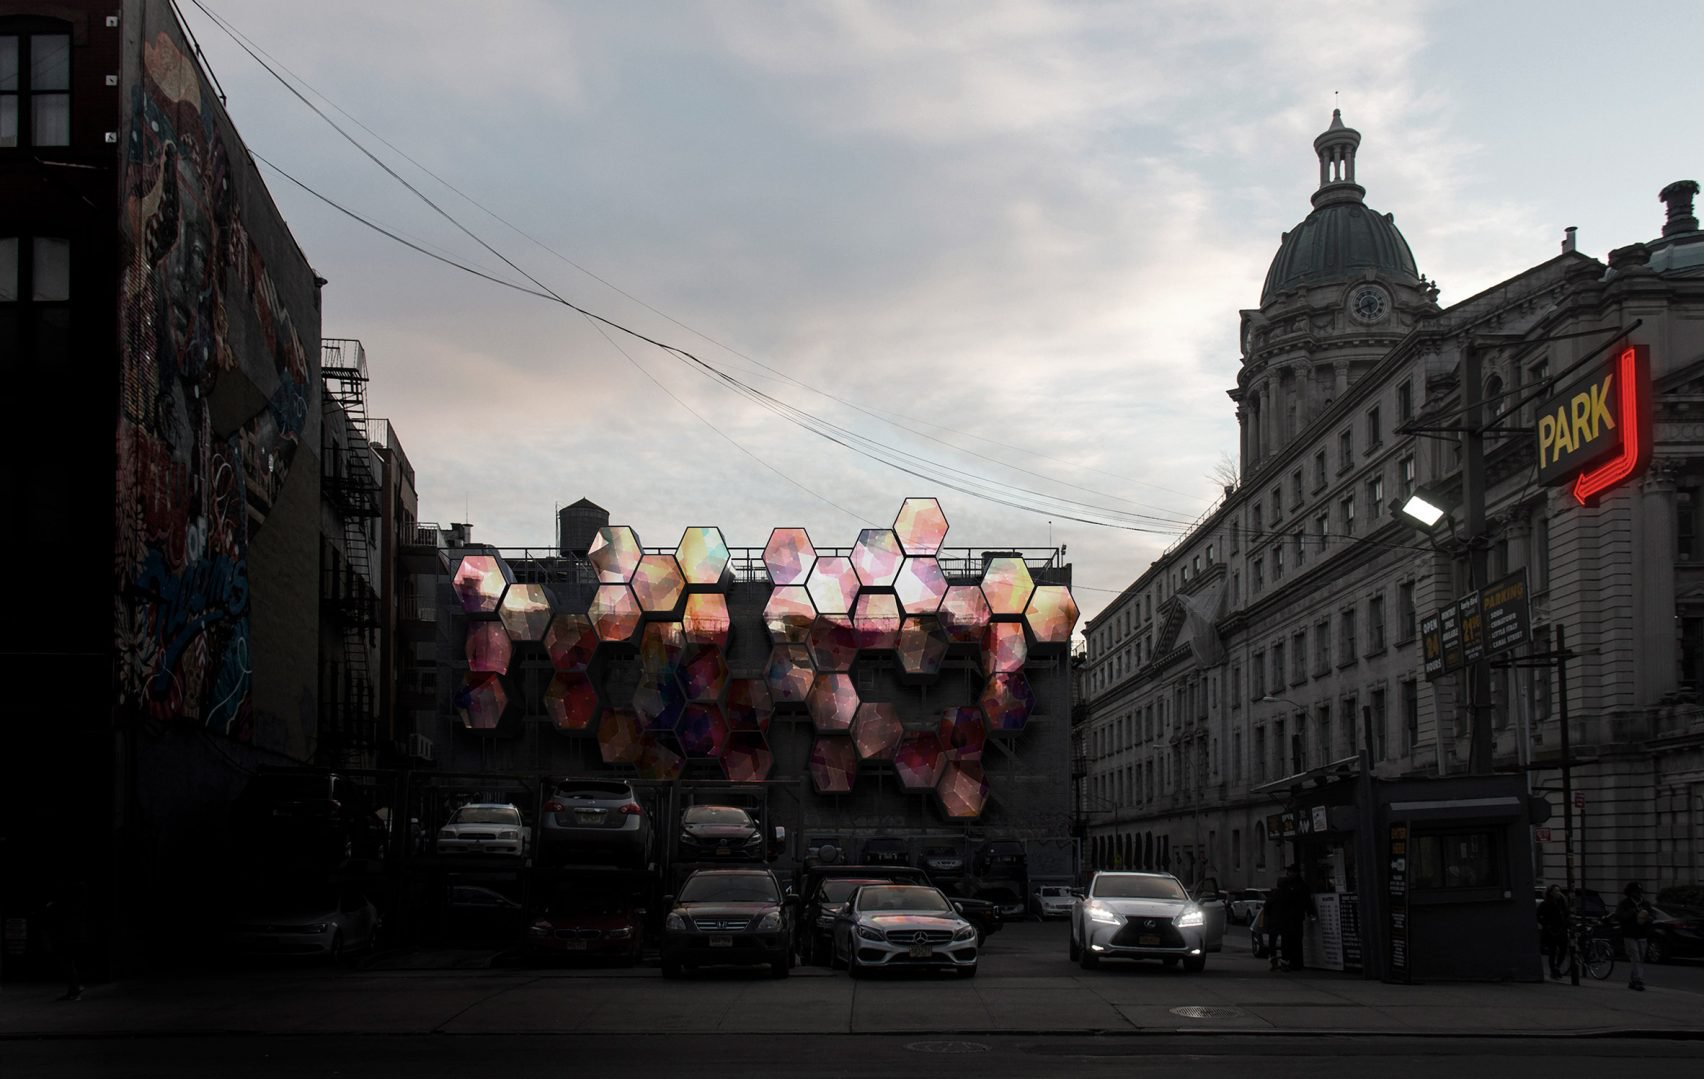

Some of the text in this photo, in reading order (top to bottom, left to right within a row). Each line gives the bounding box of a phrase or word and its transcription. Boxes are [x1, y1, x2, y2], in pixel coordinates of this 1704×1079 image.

[1538, 373, 1616, 470] PARK
[1483, 582, 1523, 609] PARKING
[1423, 618, 1438, 634] OPEN
[1426, 658, 1442, 673] HOURS
